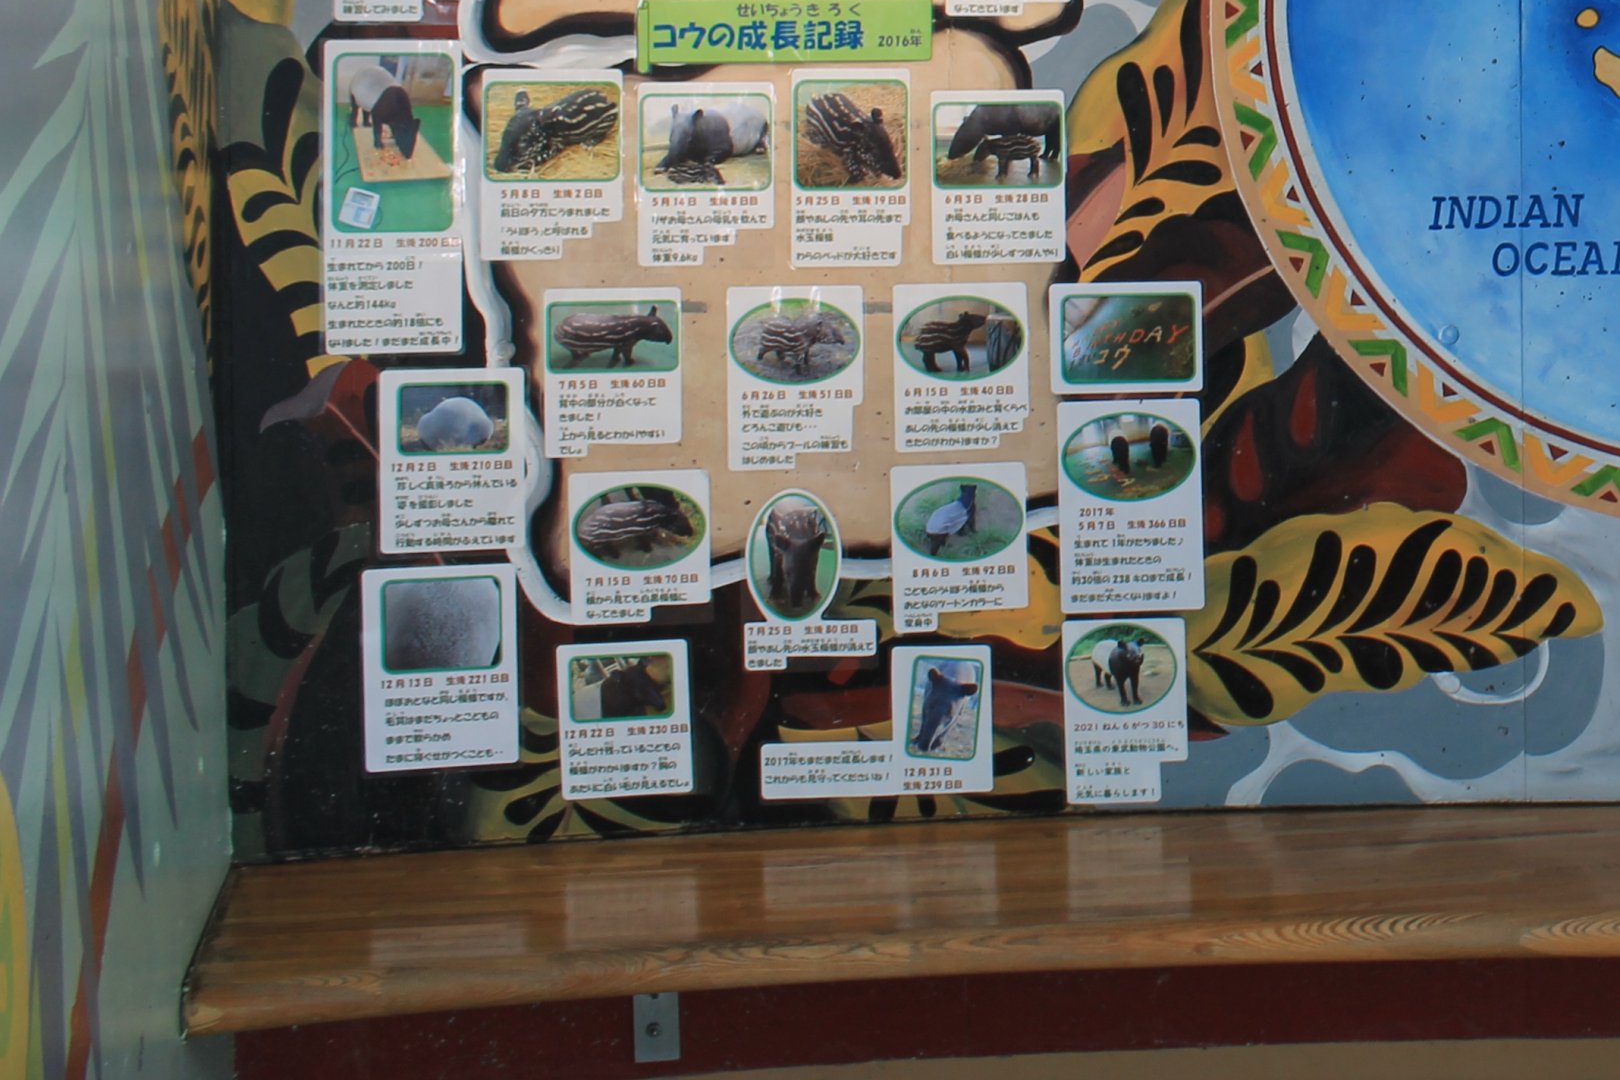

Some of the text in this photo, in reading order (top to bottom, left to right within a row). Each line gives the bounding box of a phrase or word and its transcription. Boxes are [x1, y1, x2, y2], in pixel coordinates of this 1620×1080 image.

[737, 4, 861, 16] せいちょうきろく
[653, 20, 921, 50] コウの成長記録 2016年
[1428, 193, 1585, 230] INDIAN
[1080, 508, 1115, 517] 2017年
